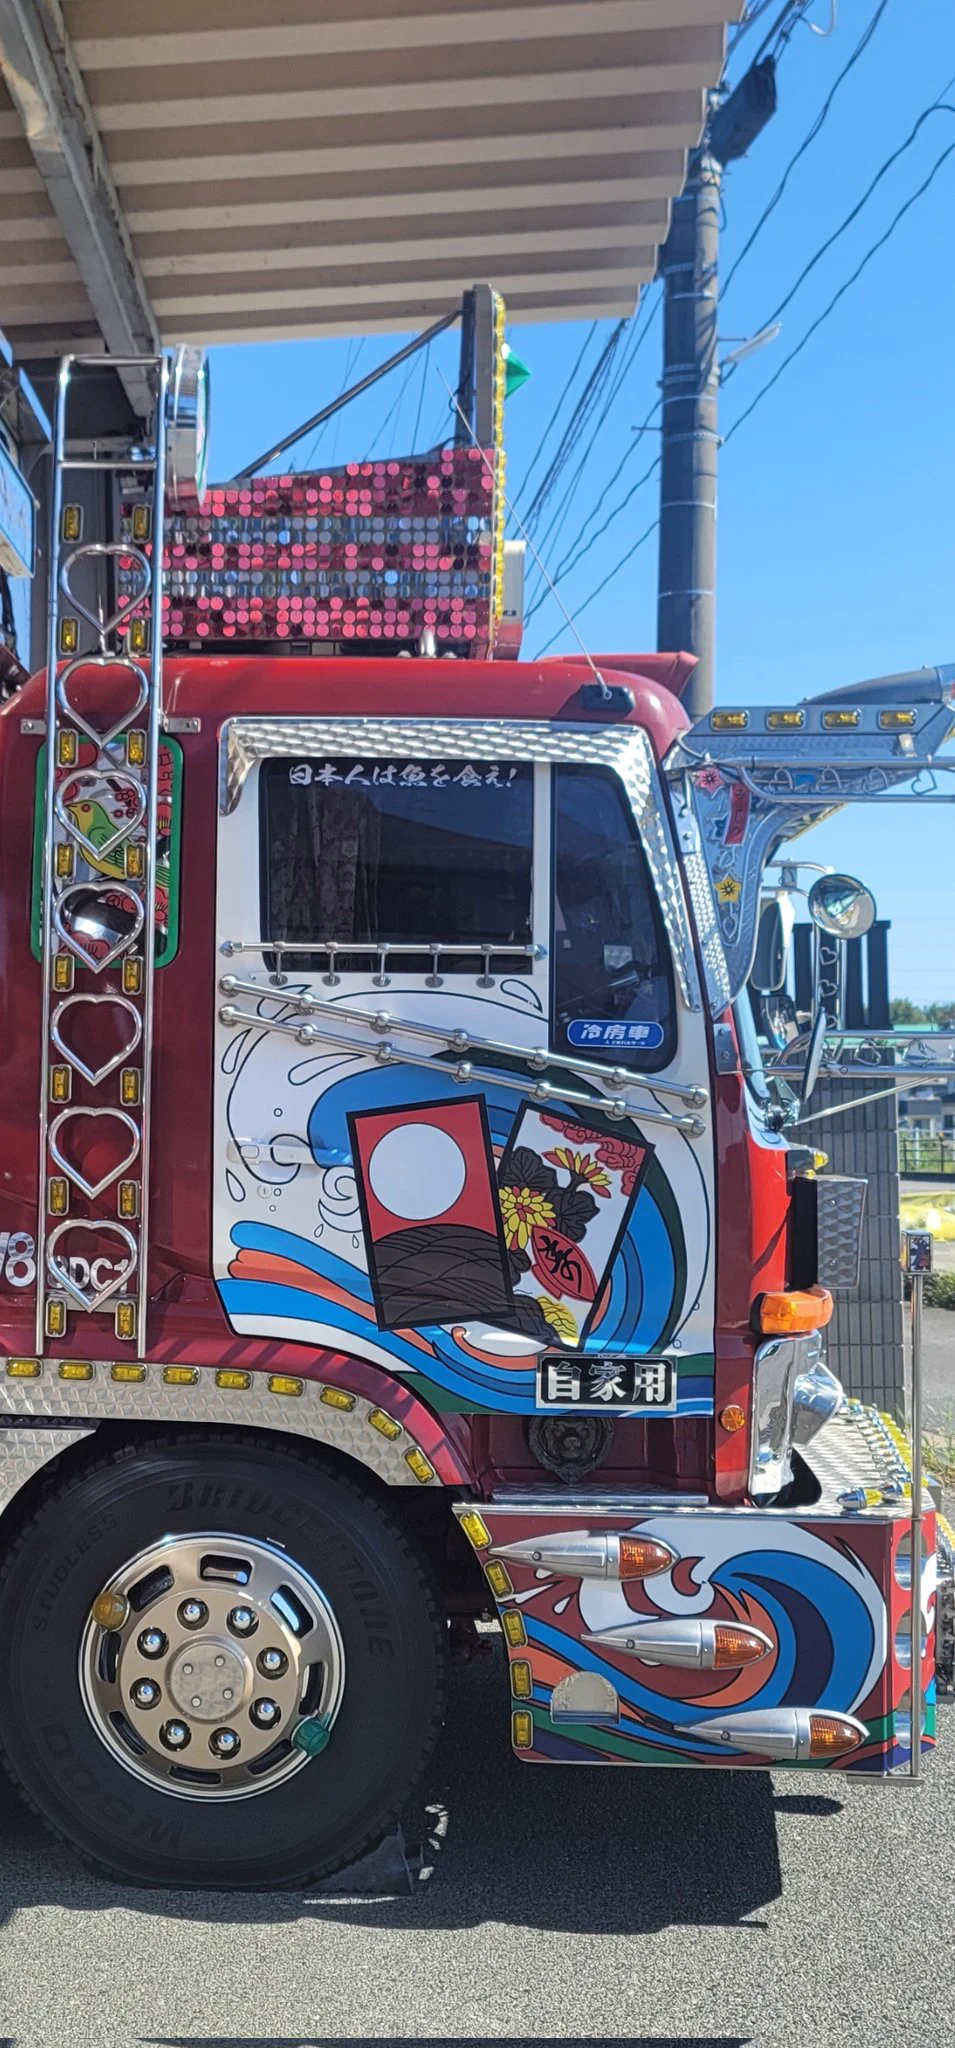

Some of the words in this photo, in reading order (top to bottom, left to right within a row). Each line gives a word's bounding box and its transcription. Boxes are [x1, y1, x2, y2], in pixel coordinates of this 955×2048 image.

[580, 1024, 650, 1040] 冷房車
[47, 1256, 141, 1295] 8DC1
[547, 1360, 666, 1402] 自家用
[33, 1513, 117, 1633] STUDLESS
